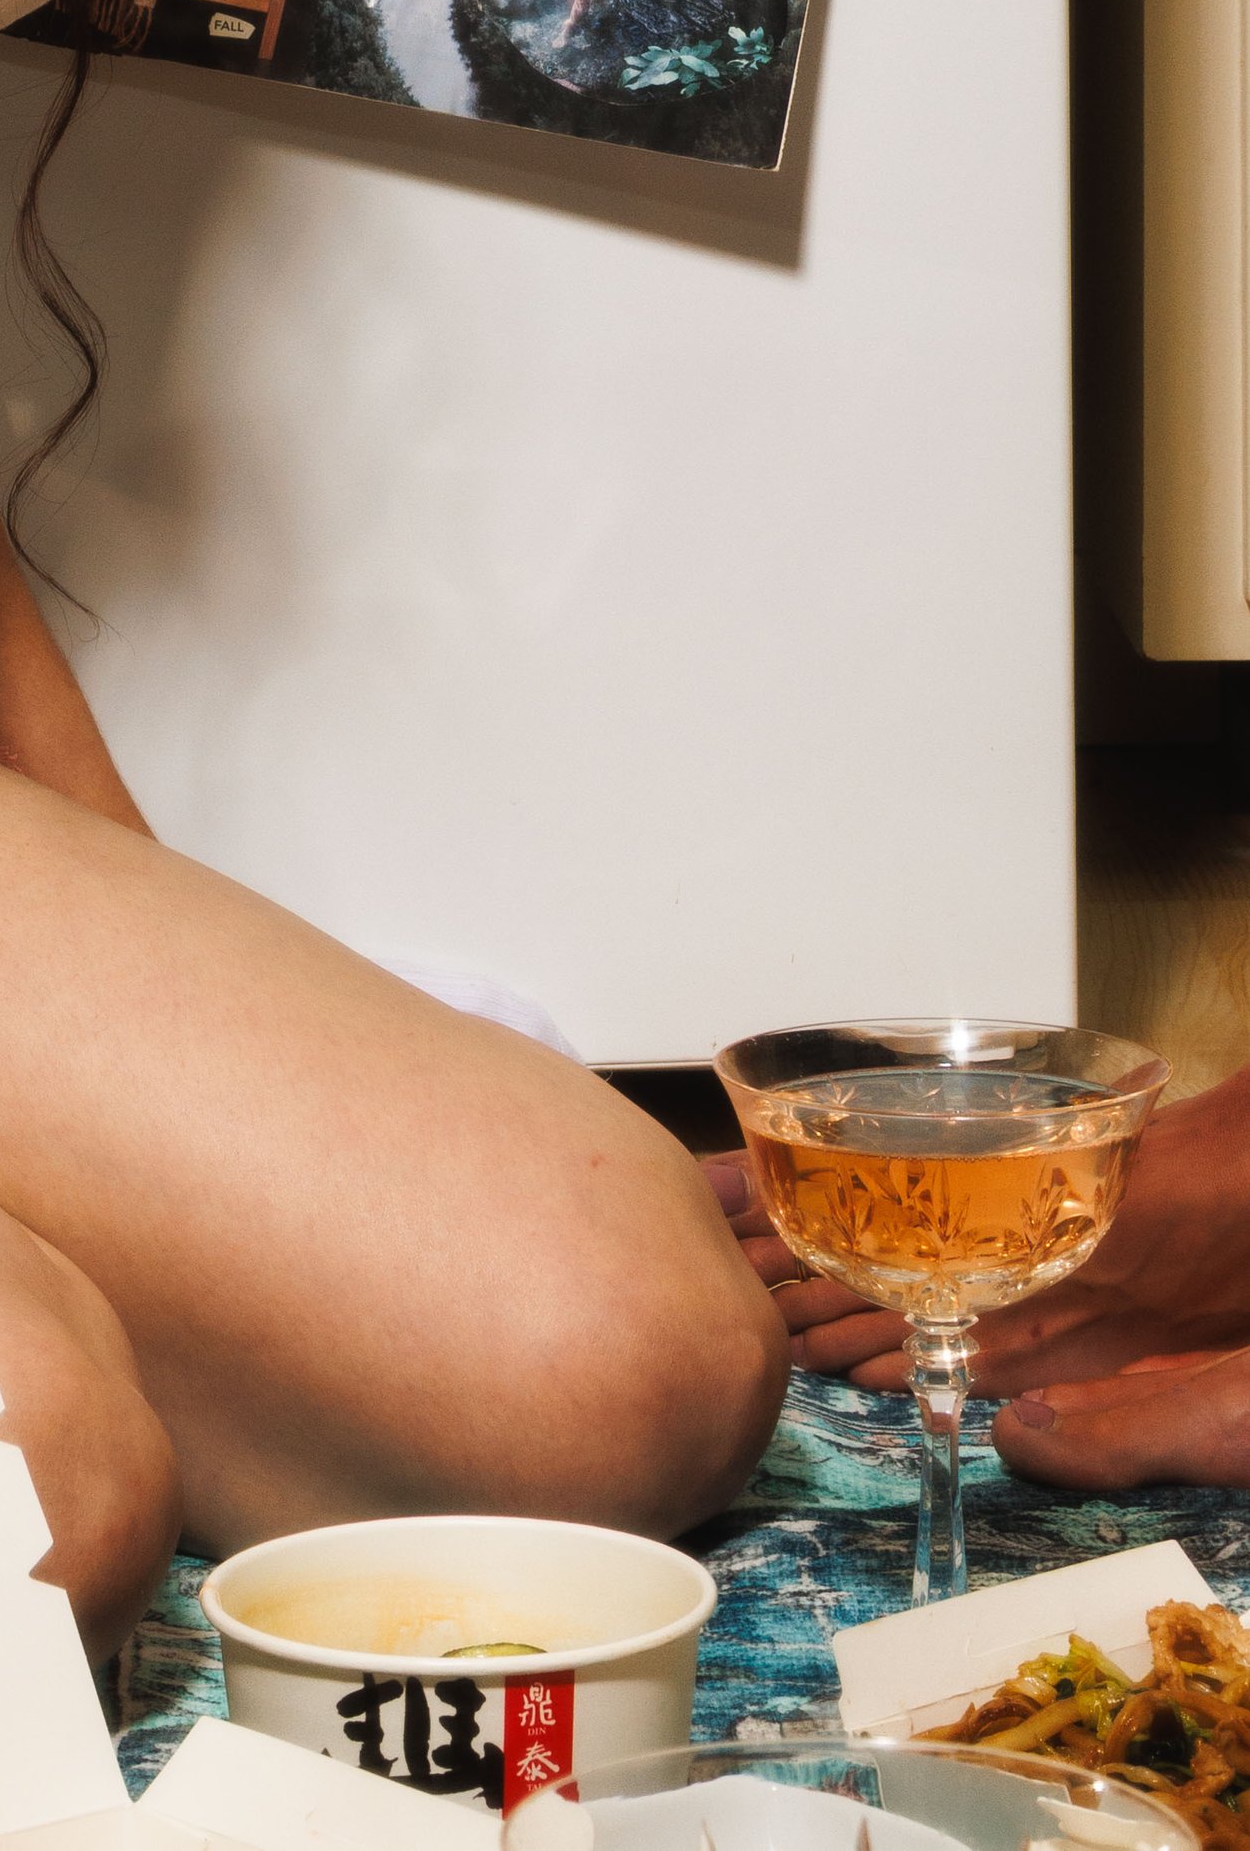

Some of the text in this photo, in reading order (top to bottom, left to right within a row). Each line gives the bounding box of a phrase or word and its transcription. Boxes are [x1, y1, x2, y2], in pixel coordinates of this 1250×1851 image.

[213, 19, 245, 33] FALL
[527, 1727, 547, 1736] DIN
[516, 1740, 560, 1781] 泰
